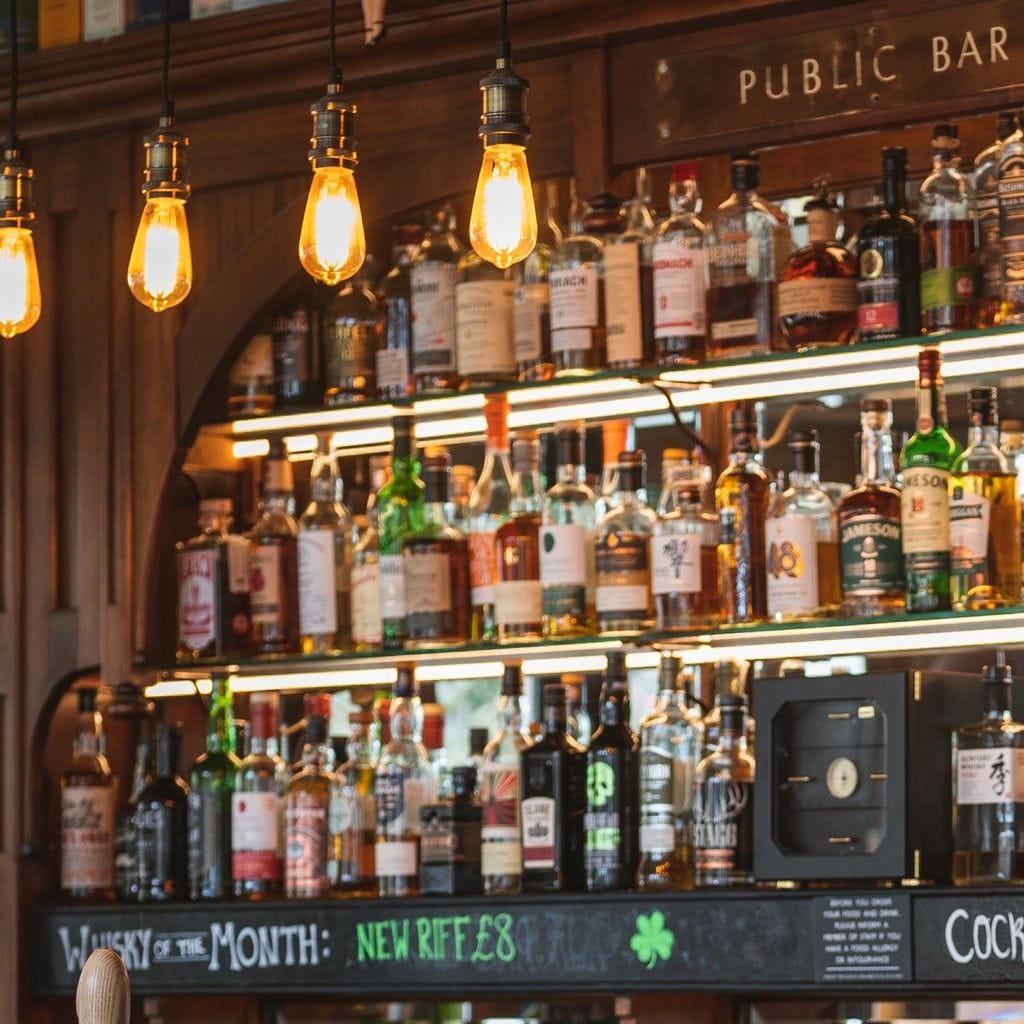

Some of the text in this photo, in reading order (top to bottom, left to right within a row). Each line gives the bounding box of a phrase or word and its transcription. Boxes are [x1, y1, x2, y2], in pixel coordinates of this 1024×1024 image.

[739, 26, 1009, 105] PUBLIC BAR
[842, 523, 900, 543] JAMESON
[153, 939, 172, 959] OF
[176, 937, 207, 957] THE
[208, 921, 330, 971] MONTH:
[356, 912, 518, 963] NEW RIFF £8
